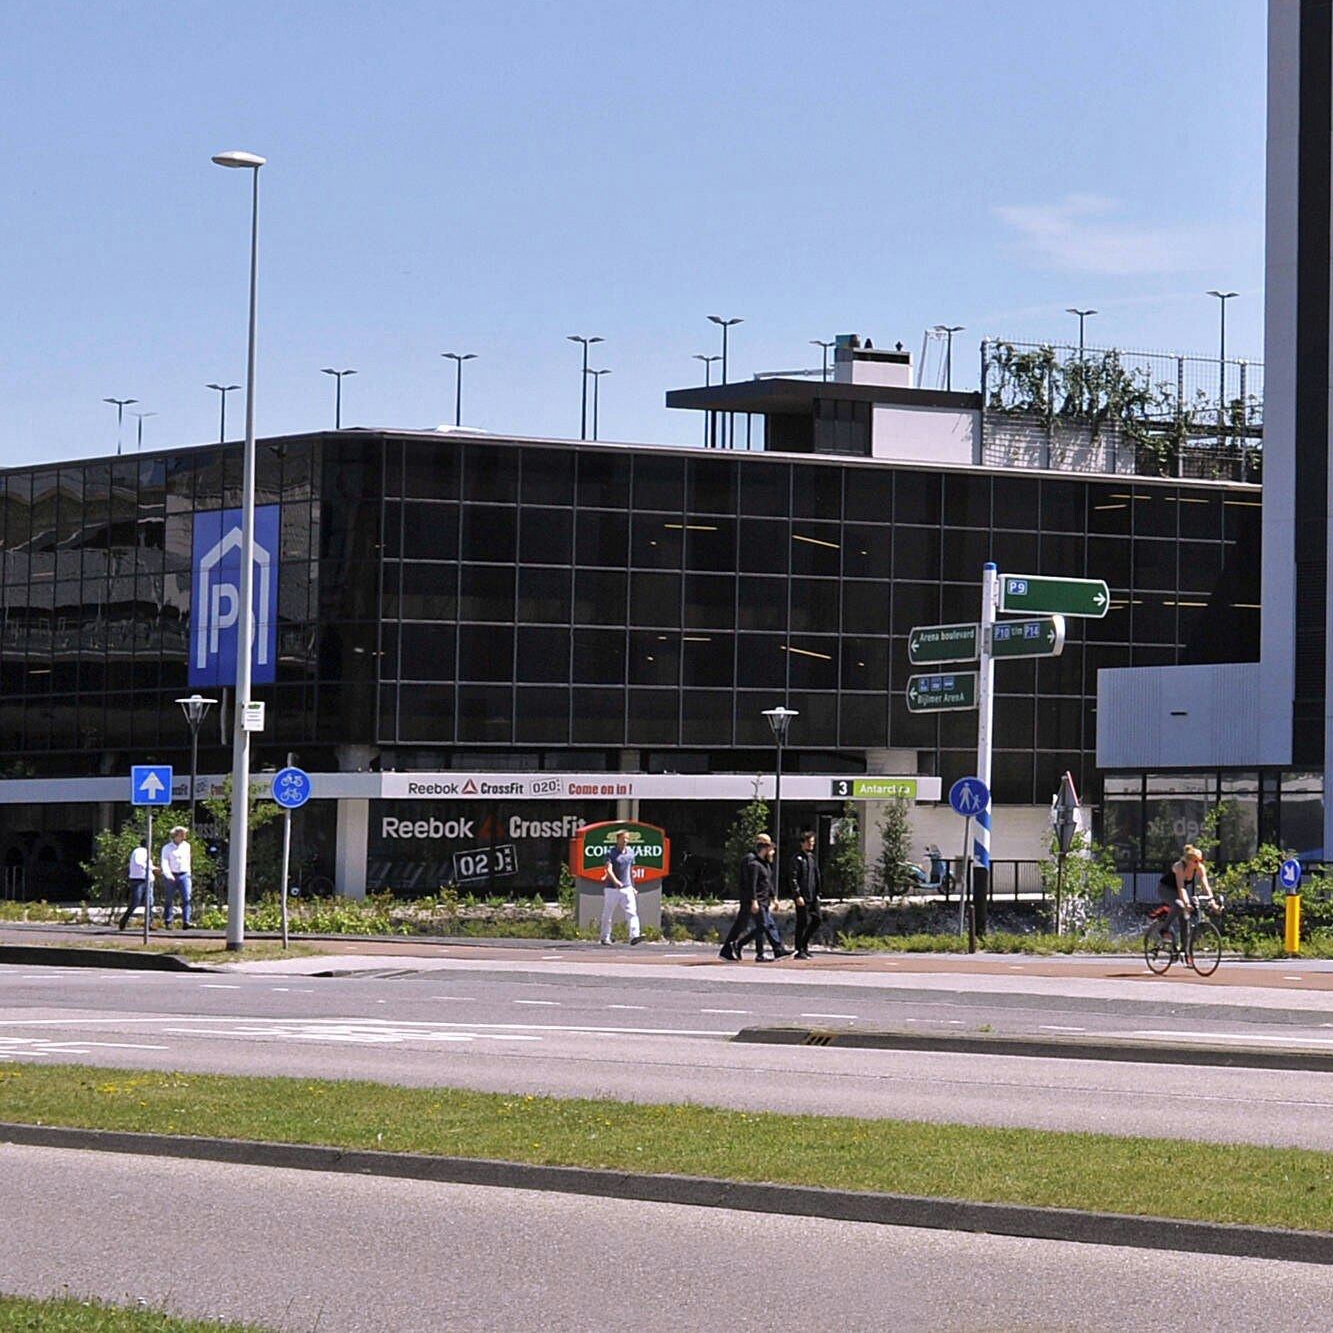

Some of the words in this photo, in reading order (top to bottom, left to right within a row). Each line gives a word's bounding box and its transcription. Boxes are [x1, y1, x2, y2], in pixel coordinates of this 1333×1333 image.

[920, 632, 940, 642] Arena
[941, 629, 974, 640] boulevard
[408, 782, 458, 794] Reebok
[480, 782, 524, 794] CrossFit
[569, 783, 599, 794] Come
[601, 784, 614, 794] on
[838, 781, 848, 795] 3
[860, 784, 911, 794] Antarctca
[382, 817, 474, 839] Reebok
